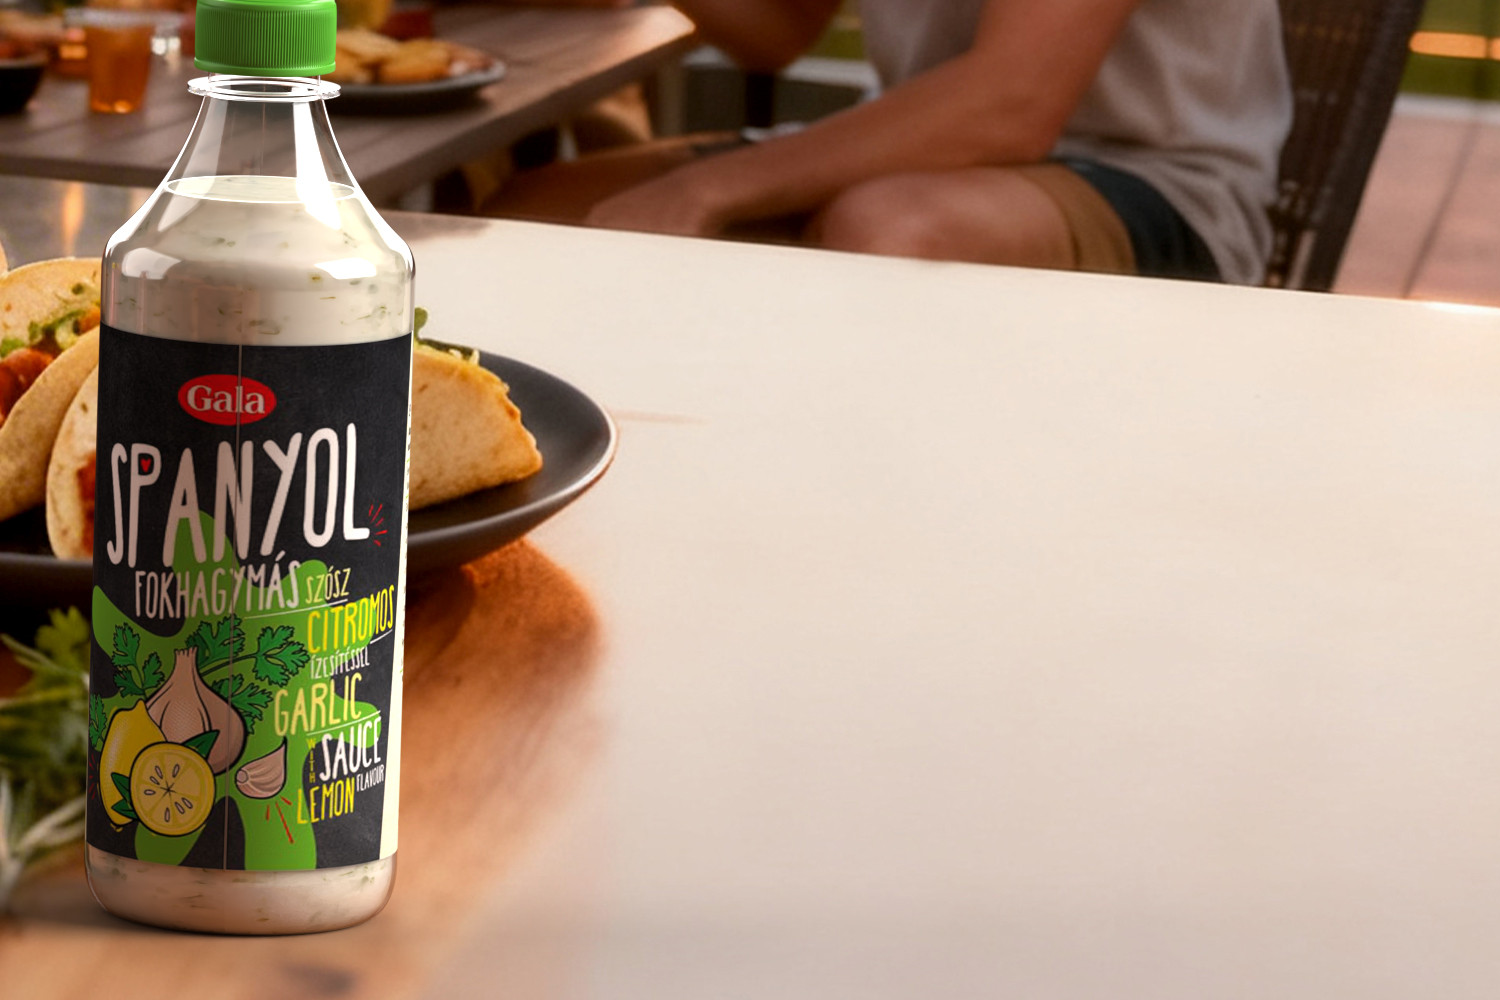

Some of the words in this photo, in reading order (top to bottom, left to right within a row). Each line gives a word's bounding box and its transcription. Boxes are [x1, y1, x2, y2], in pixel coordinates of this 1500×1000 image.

[186, 384, 266, 415] Gala
[106, 422, 371, 569] SPANYOL
[134, 550, 301, 620] FOKHAGYMÁS
[305, 565, 351, 604] SZÓSZ
[307, 584, 395, 654] CITROMOS
[310, 645, 371, 680] ÍZESÍTÉSSEL
[274, 671, 363, 737] GARLIC
[306, 737, 317, 784] WITH
[319, 715, 382, 782] SAUCE
[296, 777, 356, 825] LEMON
[356, 763, 385, 793] FLAVOUR
